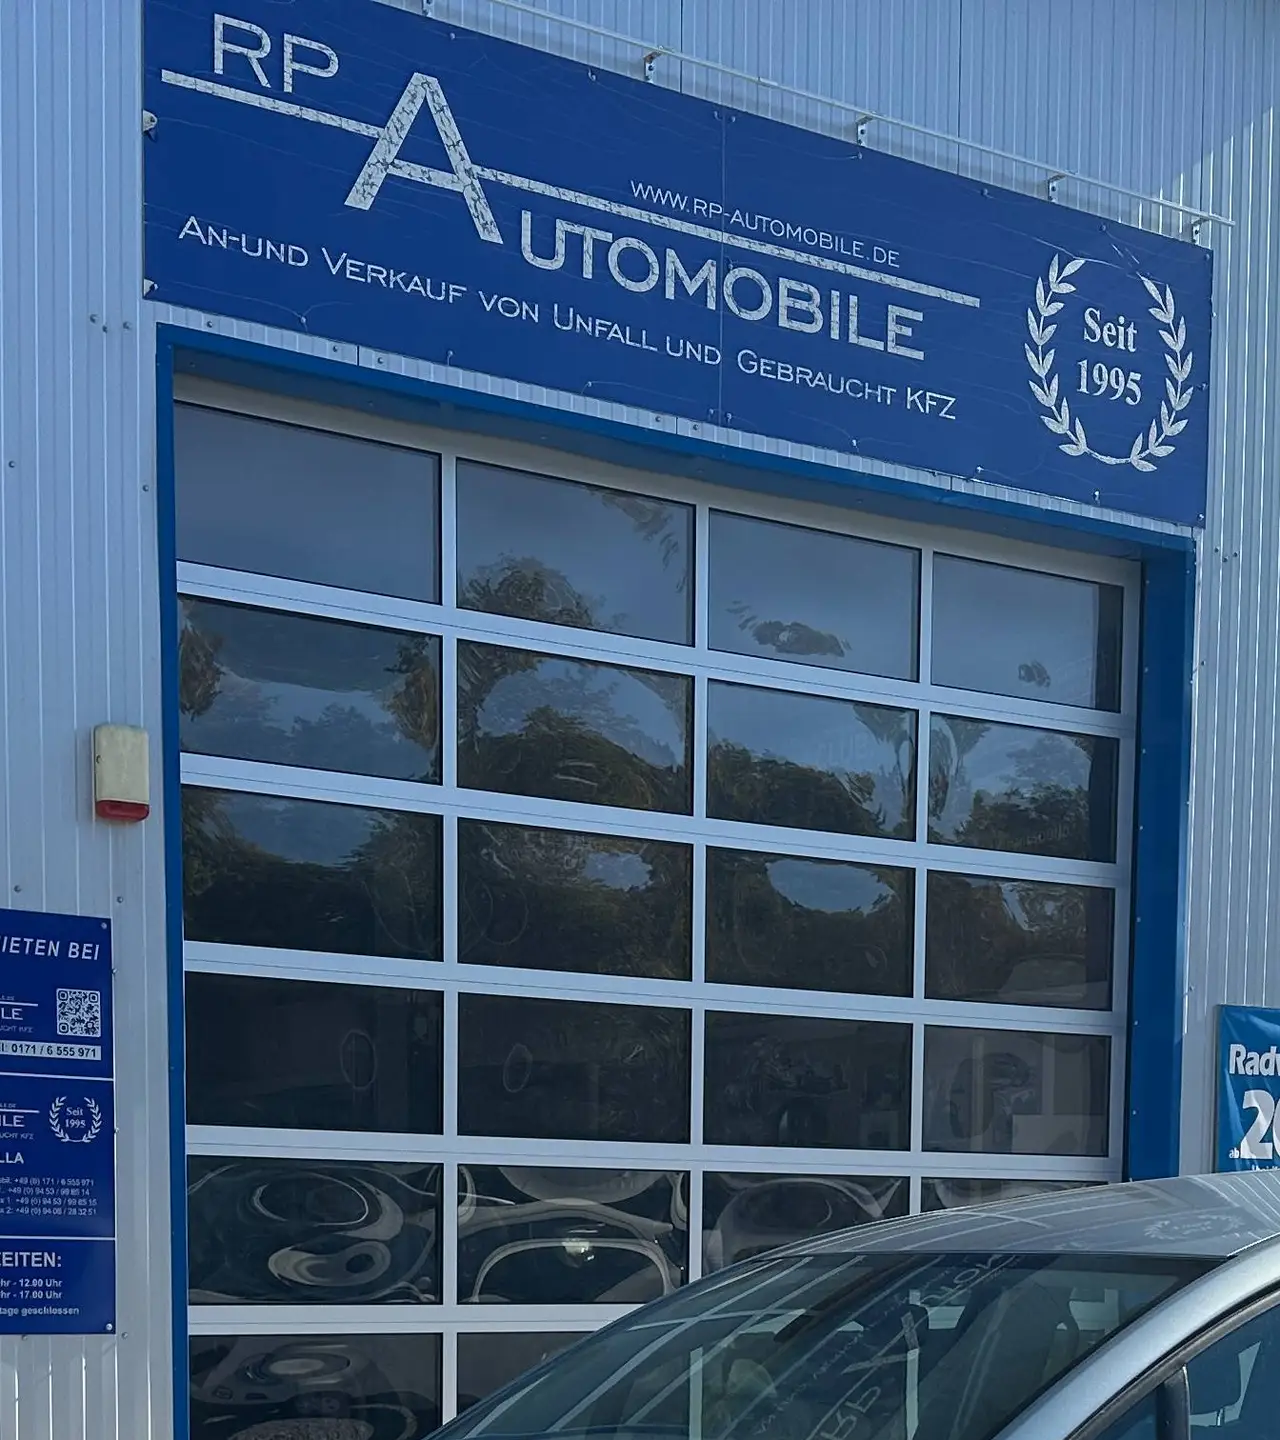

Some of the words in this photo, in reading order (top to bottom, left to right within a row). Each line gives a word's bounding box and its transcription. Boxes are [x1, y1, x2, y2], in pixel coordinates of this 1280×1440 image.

[213, 13, 340, 94] RP
[345, 72, 925, 361] AUTOMOBILE
[322, 248, 467, 302] VERKAUF
[478, 291, 539, 324] VON
[553, 307, 658, 352] UNFALL
[666, 336, 722, 366] UND
[737, 349, 896, 406] GEBRAUCHT
[905, 387, 957, 420] KFZ
[1083, 307, 1138, 353] Seit
[1076, 359, 1142, 406] 1995
[68, 942, 100, 960] BEI
[11, 1044, 36, 1055] 0171
[47, 1046, 53, 1055] 6
[56, 1046, 75, 1057] 555
[78, 1047, 96, 1058] 971
[66, 1107, 83, 1116] Seit
[65, 1118, 86, 1129] 1995
[1229, 1146, 1239, 1158] ab
[45, 1279, 62, 1287] Uhr
[45, 1291, 62, 1299] Uhr
[21, 1306, 79, 1316] geschlossen
